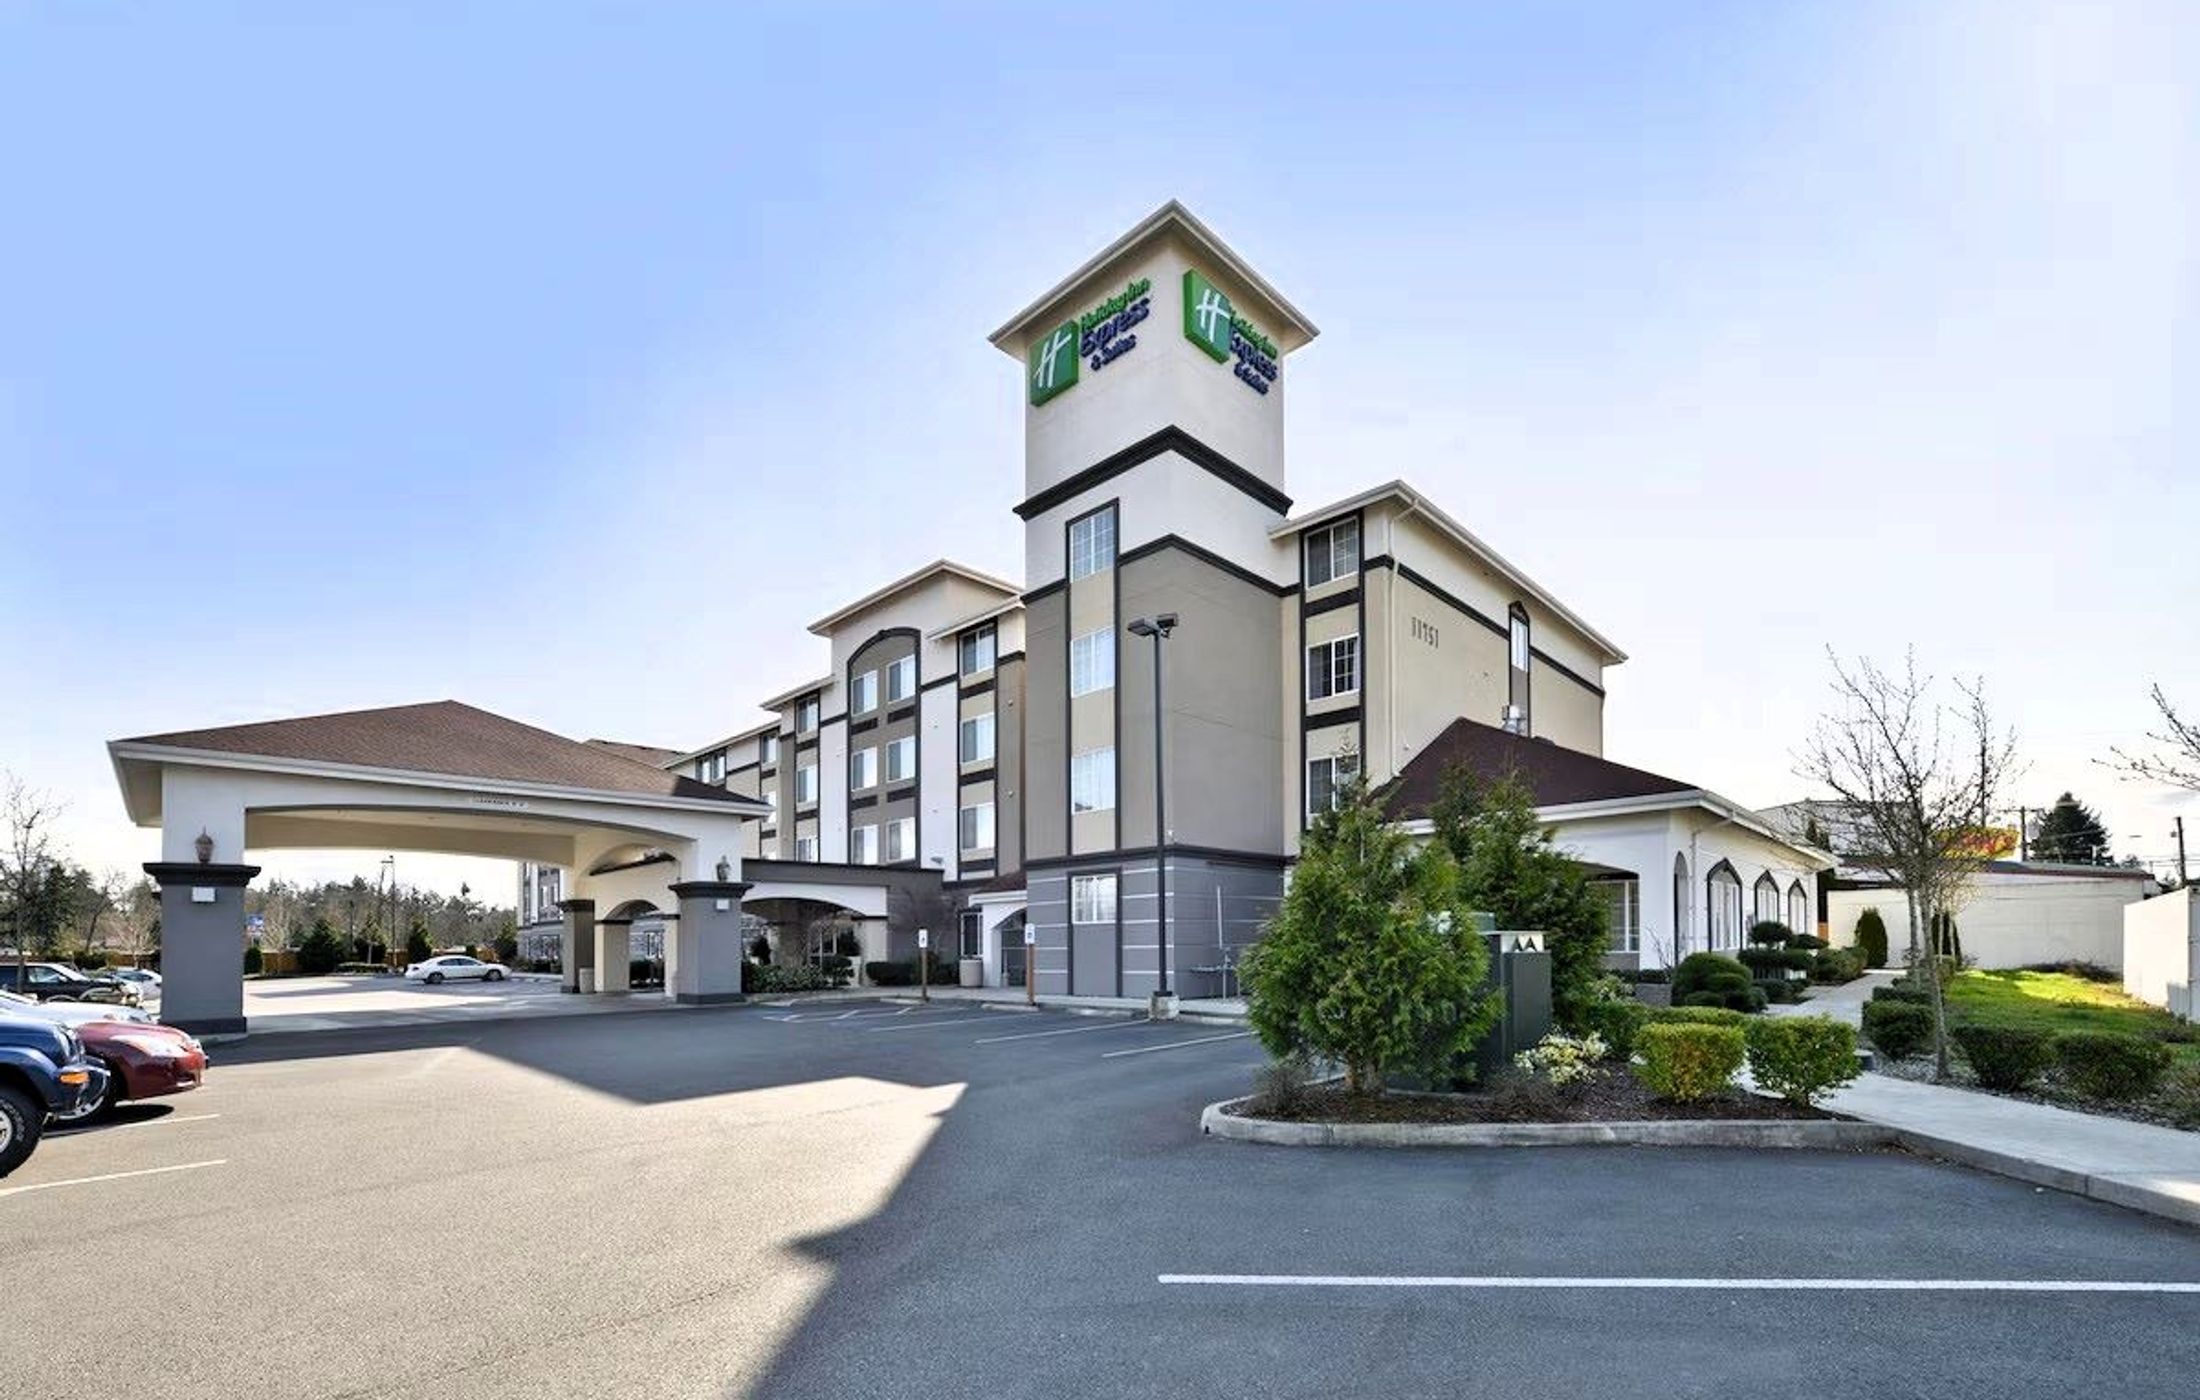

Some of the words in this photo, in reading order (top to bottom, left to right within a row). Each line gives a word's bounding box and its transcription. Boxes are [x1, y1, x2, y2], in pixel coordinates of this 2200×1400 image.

[1127, 277, 1151, 303] Inn
[1080, 298, 1150, 358] Express
[1411, 616, 1439, 649] 11751
